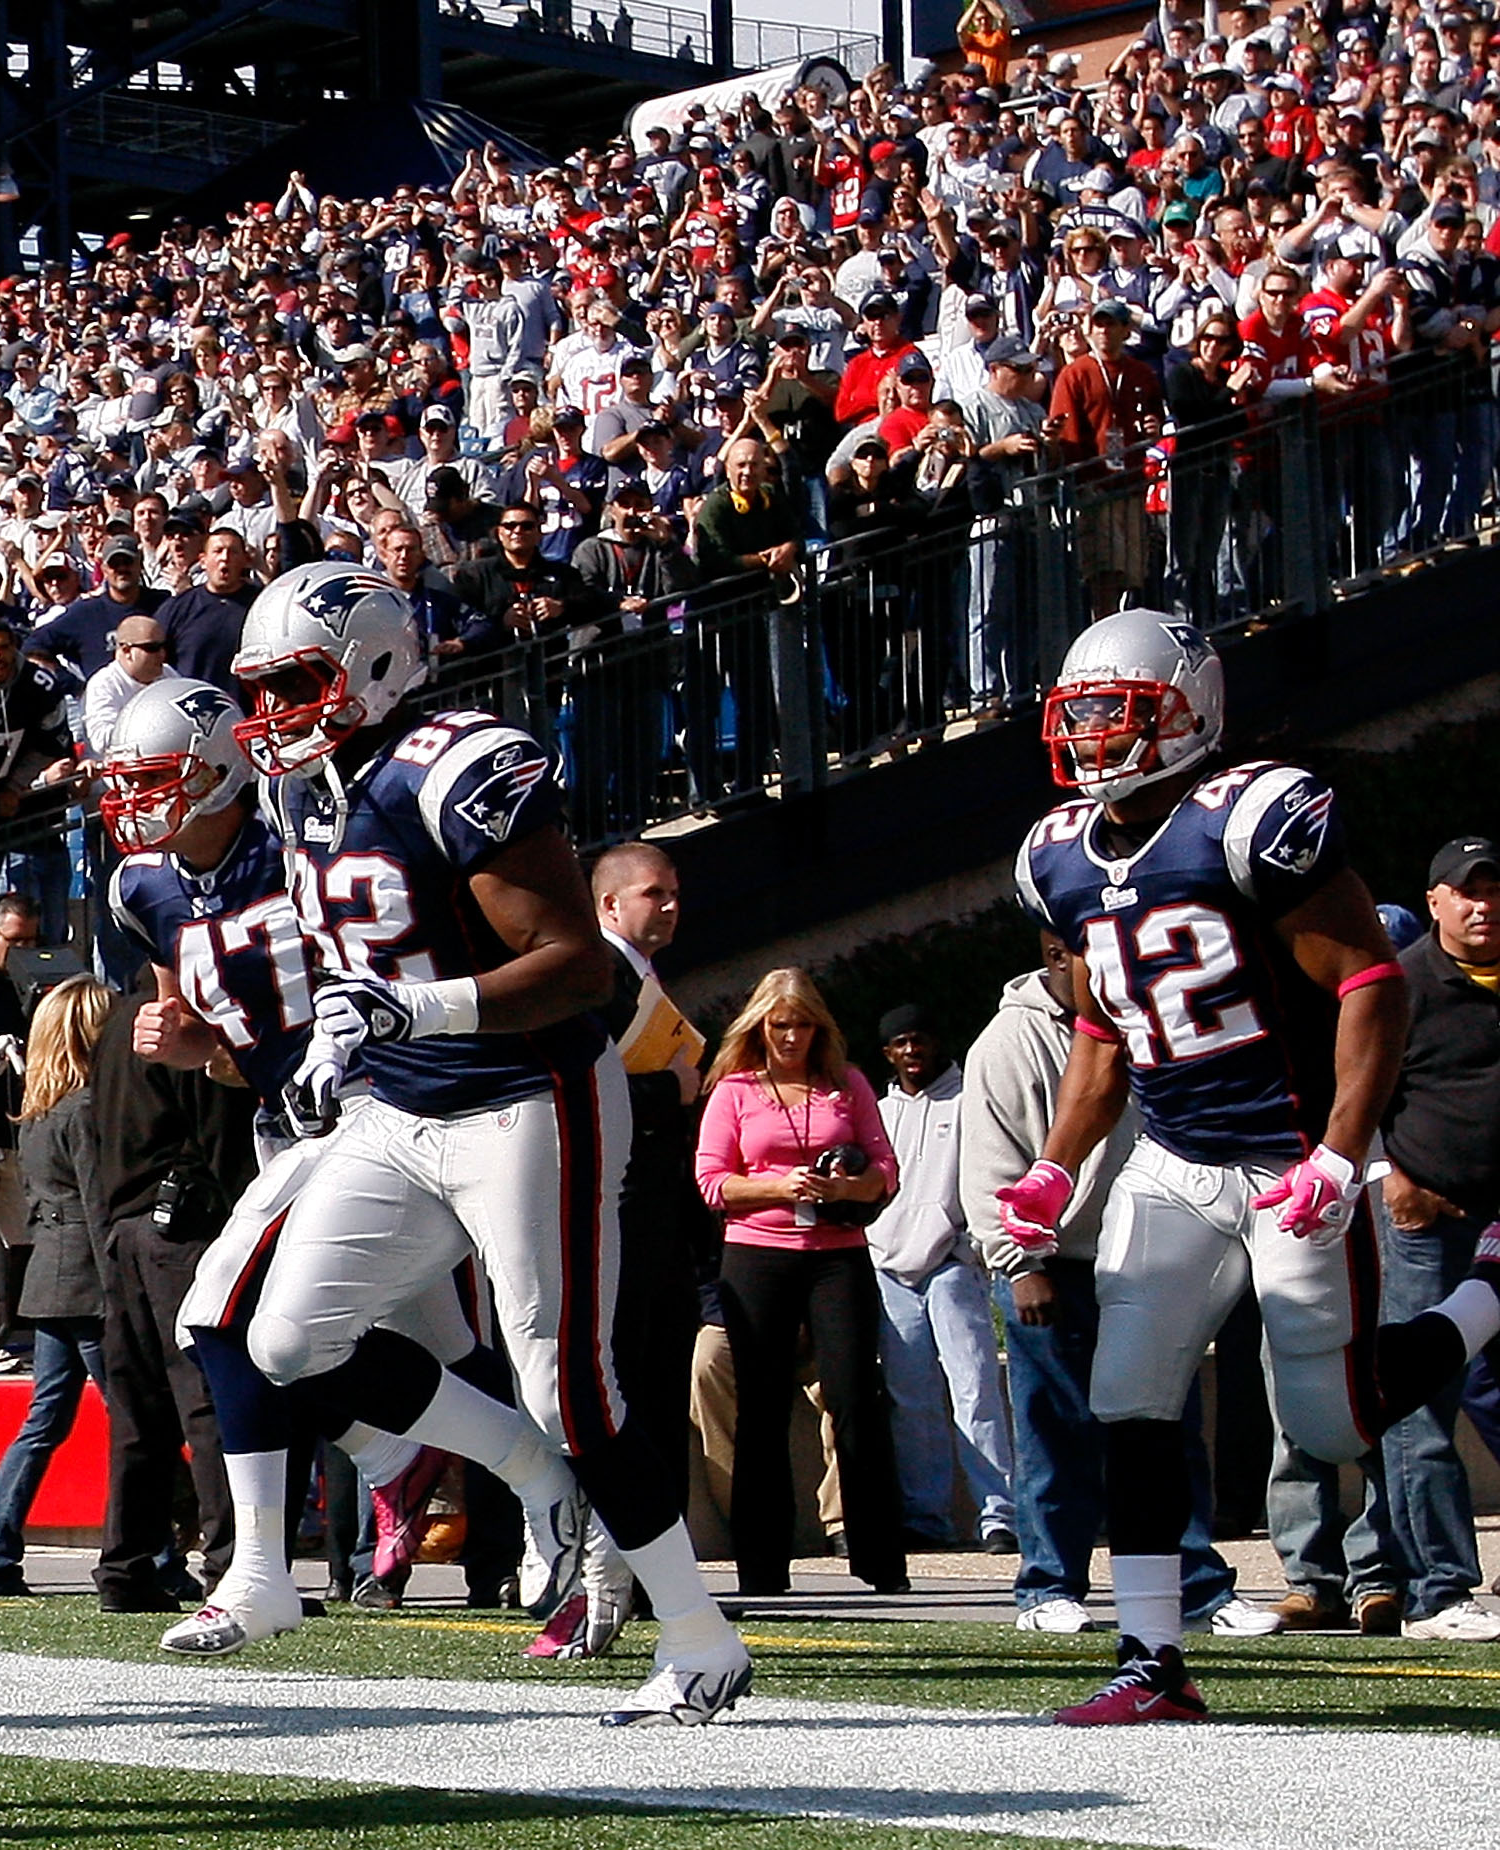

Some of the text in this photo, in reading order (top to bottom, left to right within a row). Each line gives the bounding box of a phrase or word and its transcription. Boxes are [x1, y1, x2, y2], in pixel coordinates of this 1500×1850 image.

[580, 372, 618, 417] 12
[175, 884, 317, 1052] 47
[1082, 902, 1269, 1070] 42
